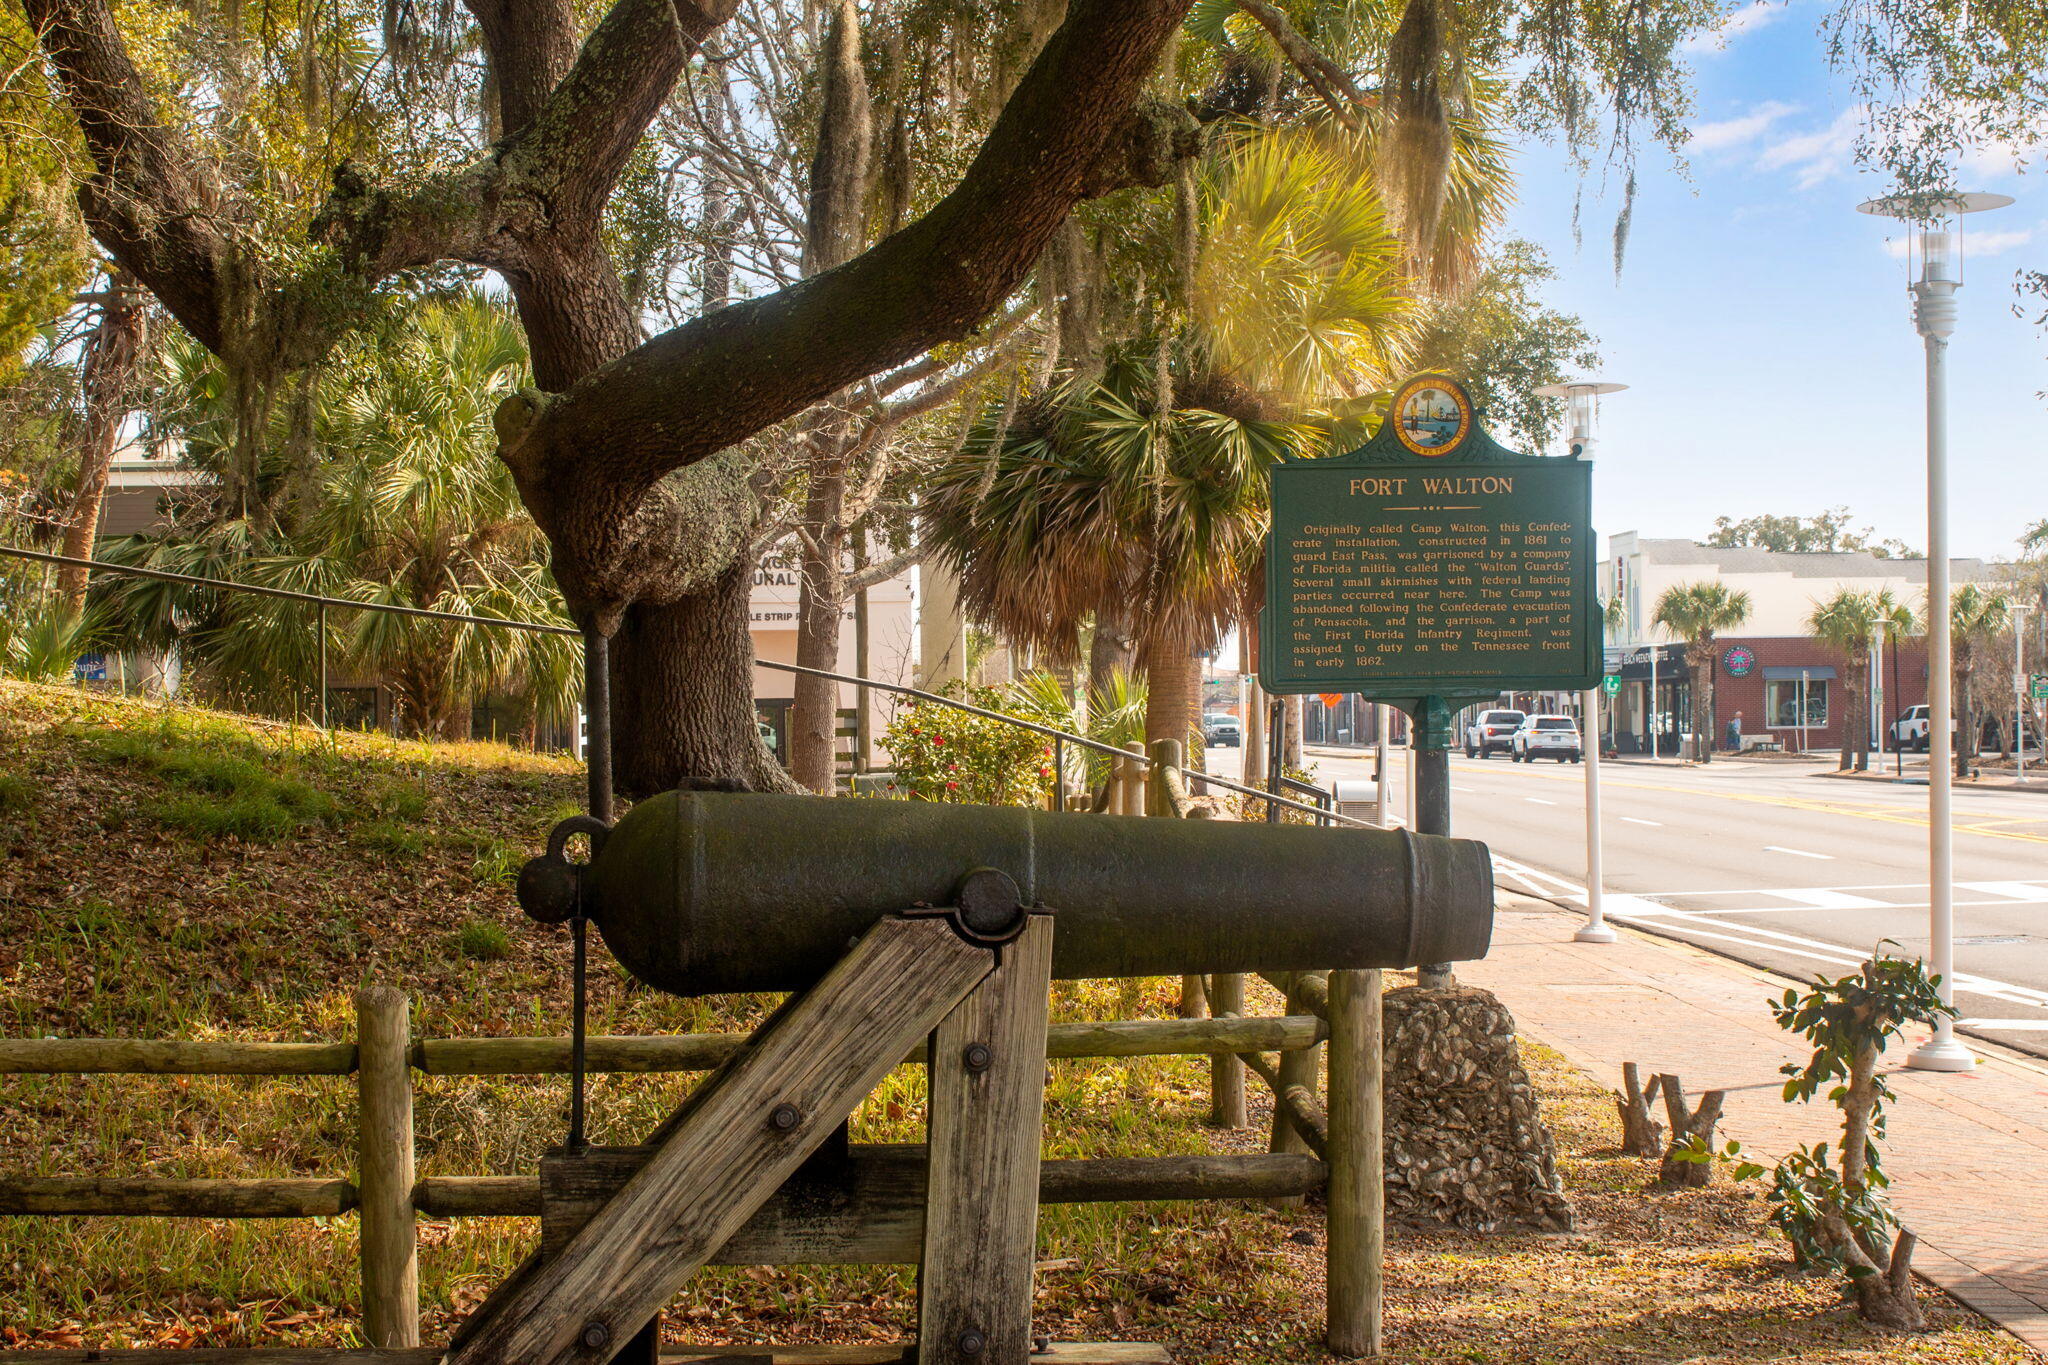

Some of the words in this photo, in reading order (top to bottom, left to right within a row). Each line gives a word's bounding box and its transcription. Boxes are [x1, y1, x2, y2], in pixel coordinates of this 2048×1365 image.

[1350, 478, 1408, 496] FORT
[1422, 477, 1513, 494] WALTON
[1304, 525, 1360, 536] Originally
[1369, 524, 1402, 533] called
[1411, 524, 1442, 534] Camp
[1500, 522, 1520, 532] this
[1528, 522, 1571, 531] Confed-
[1293, 540, 1322, 548] erate
[1419, 536, 1487, 546] constructed
[1500, 536, 1510, 545] in
[1524, 535, 1546, 544] 1861
[1293, 552, 1326, 563] guard
[1333, 551, 1354, 560] East
[1423, 550, 1484, 562] garrisoned
[1490, 550, 1504, 560] by
[1523, 551, 1570, 559] company
[1293, 565, 1304, 574] of
[1313, 564, 1351, 573] Florida
[1360, 564, 1396, 572] militia
[1405, 564, 1438, 572] called
[1448, 563, 1466, 572] the
[754, 572, 796, 586] URAL
[1293, 578, 1333, 587] Several
[1342, 577, 1371, 586] small
[1380, 577, 1438, 586] skirmishes
[1448, 576, 1472, 584] with
[1482, 576, 1521, 584] federal
[1530, 575, 1570, 586] landing
[1294, 592, 1332, 602] parties
[1342, 591, 1394, 599] occurred
[1440, 590, 1467, 598] here.
[1480, 589, 1502, 598] The
[1511, 588, 1542, 599] Camp
[1293, 604, 1352, 614] abandoned
[1360, 604, 1409, 614] following
[1417, 604, 1434, 612] the
[1440, 603, 1507, 612] Confederate
[1513, 602, 1570, 611] evacuation
[751, 613, 762, 621] LE
[765, 612, 792, 621] STRIP
[1293, 618, 1304, 626] of
[1386, 616, 1406, 626] and
[1417, 616, 1434, 625] the
[1526, 616, 1549, 626] part
[1559, 614, 1571, 623] of
[1294, 632, 1311, 640] the
[1326, 631, 1350, 640] First
[1365, 630, 1404, 639] Florida
[1418, 630, 1462, 640] Infantry
[1293, 644, 1342, 656] assigned
[1377, 644, 1402, 652] duty
[1440, 643, 1458, 651] the
[1472, 642, 1530, 650] Tennessee
[1542, 640, 1570, 650] front
[1294, 658, 1304, 666] in
[1316, 658, 1344, 668] early
[1357, 656, 1384, 666] 1862.
